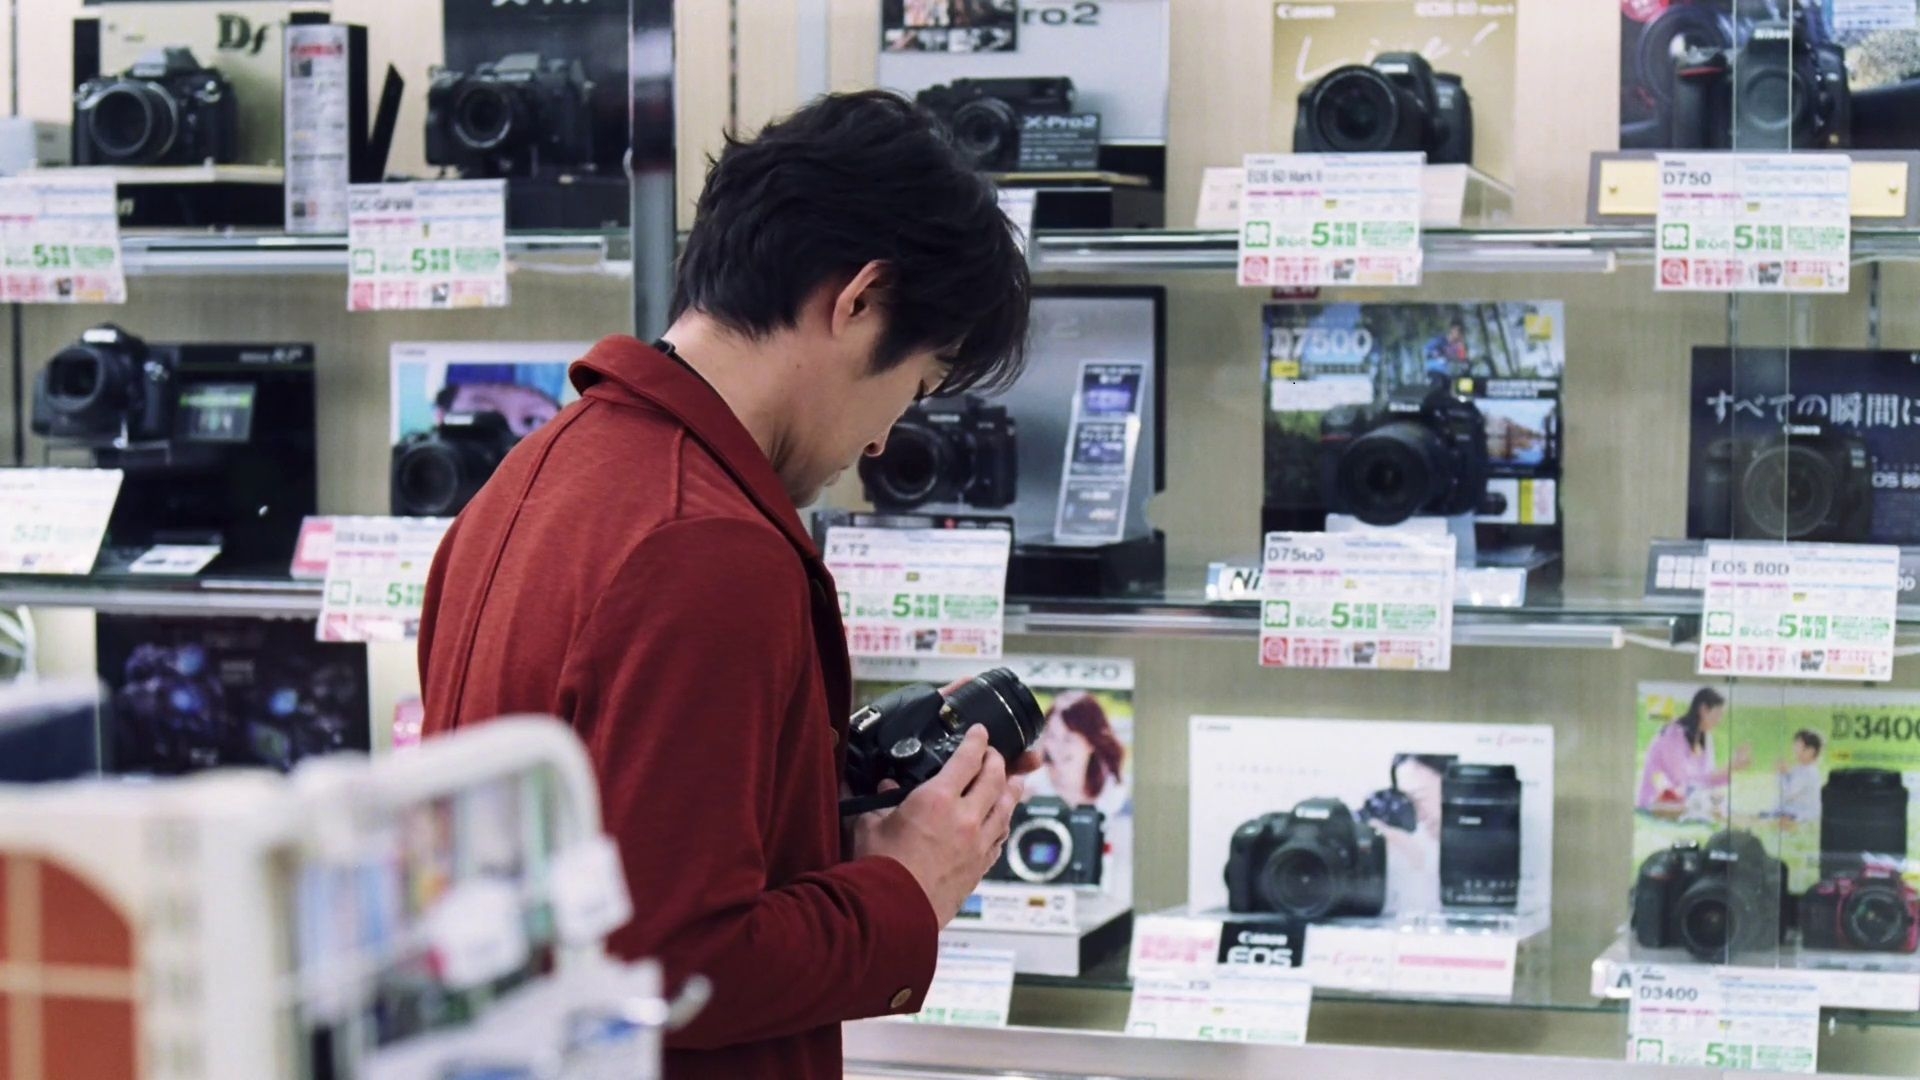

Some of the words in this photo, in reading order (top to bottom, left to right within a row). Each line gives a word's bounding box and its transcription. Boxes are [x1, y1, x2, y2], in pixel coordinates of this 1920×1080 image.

[217, 13, 268, 56] Df
[1662, 171, 1712, 187] D750
[1311, 223, 1330, 246] 5
[1734, 225, 1754, 249] 5
[412, 248, 428, 272] 5
[1270, 327, 1373, 359] D7500
[1710, 561, 1747, 576] EOS
[1753, 561, 1791, 576] 80D
[386, 582, 403, 606] 5
[892, 593, 911, 619] 5
[1331, 602, 1351, 628] 5
[1777, 614, 1799, 639] 5
[1026, 660, 1120, 679] X-T20
[1238, 930, 1288, 945] Canon
[1227, 946, 1293, 968] EOS
[1640, 986, 1699, 1003] D3400
[1705, 1042, 1726, 1067] 5
